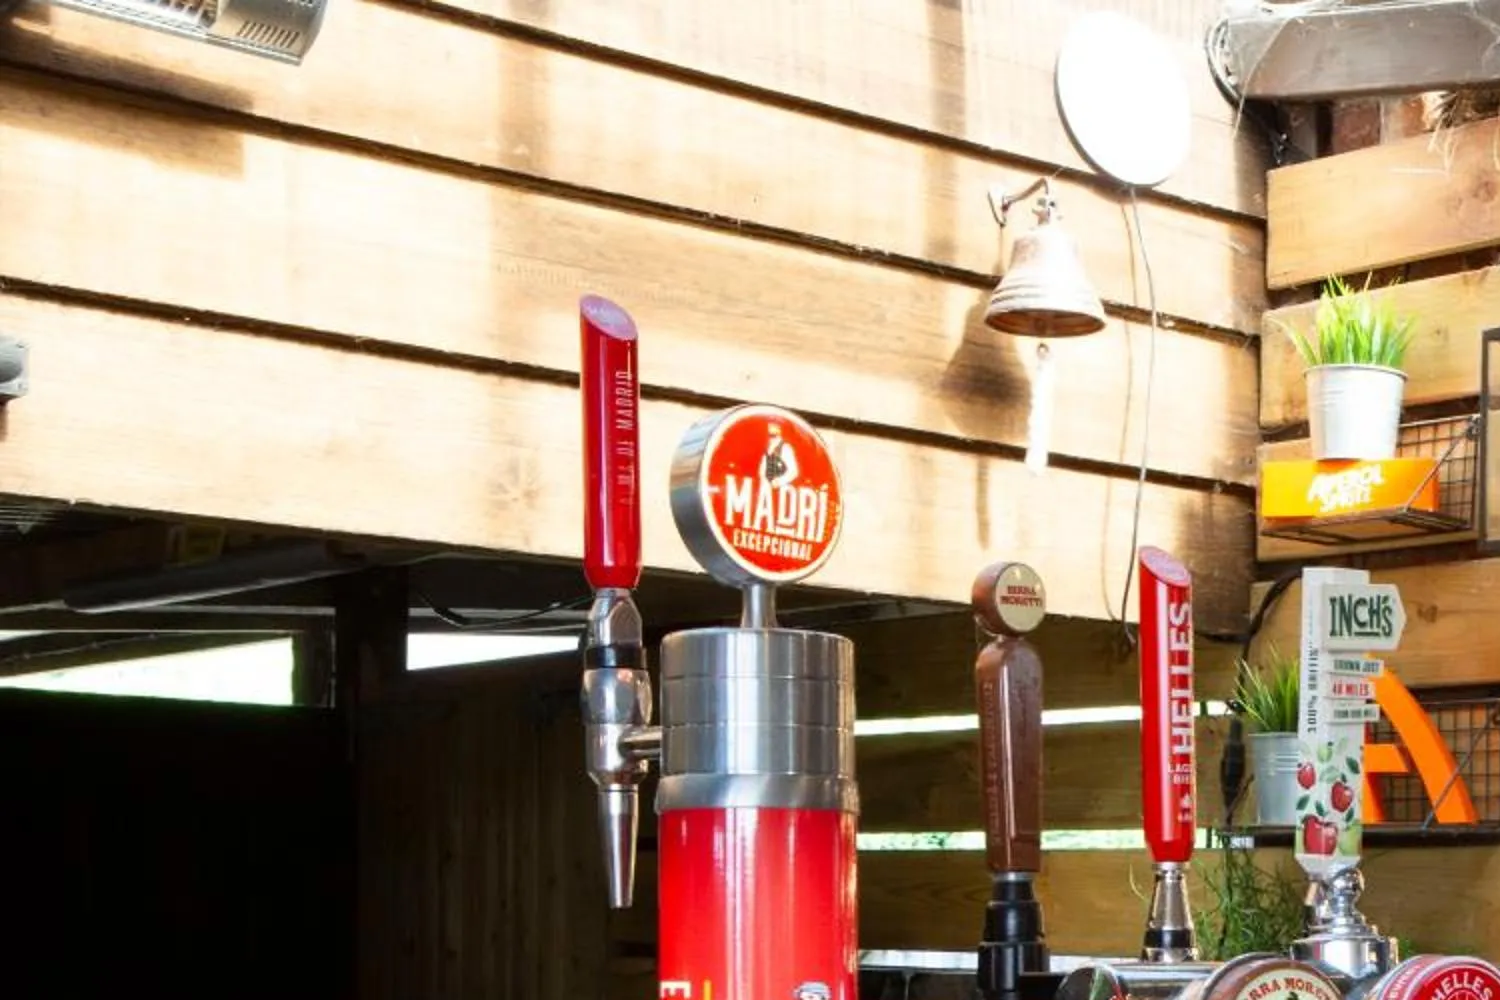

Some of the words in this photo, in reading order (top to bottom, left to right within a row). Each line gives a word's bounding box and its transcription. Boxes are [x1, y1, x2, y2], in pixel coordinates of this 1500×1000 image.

[615, 370, 635, 431] MADRID
[733, 528, 813, 561] EXCEPCIONAL
[1329, 594, 1393, 637] INCH'S
[1168, 602, 1194, 755] HELLES
